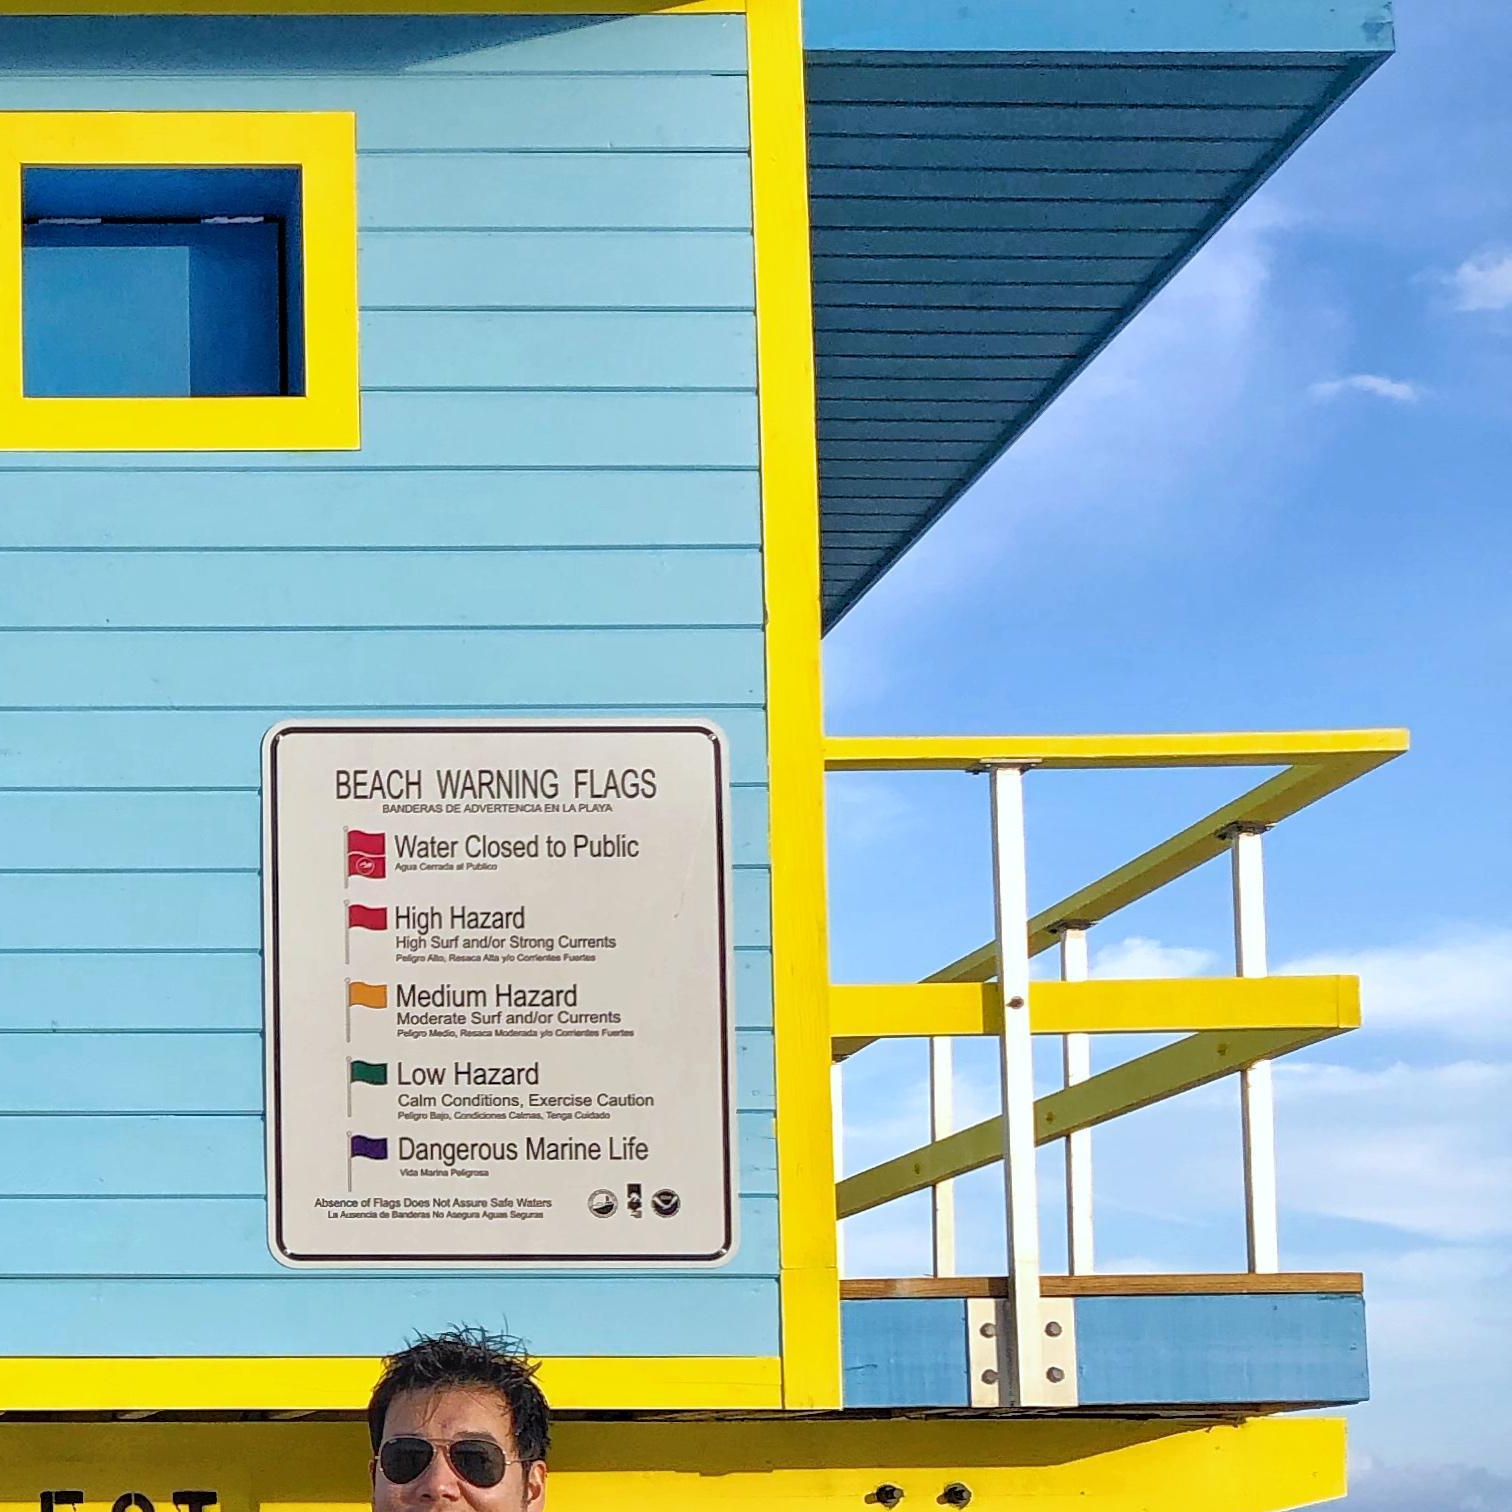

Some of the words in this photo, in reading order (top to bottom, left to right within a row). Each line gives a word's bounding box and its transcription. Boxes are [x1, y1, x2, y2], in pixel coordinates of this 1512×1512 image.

[336, 770, 421, 800] BEACH
[437, 769, 558, 800] WARNING
[574, 769, 657, 799] FLAGS
[382, 803, 443, 814] BANDERAS
[445, 803, 461, 814] DE
[463, 803, 543, 814] ADVERTENCIA
[544, 803, 560, 813] EN
[562, 803, 577, 813] LA
[578, 803, 613, 813] PLAYA
[394, 835, 459, 859] Water
[465, 835, 539, 859] Closed
[545, 836, 567, 858] to
[573, 834, 640, 858] Public
[395, 906, 443, 936] High
[450, 906, 526, 930] Hazard
[395, 935, 427, 953] High
[430, 935, 460, 949] Surf
[462, 935, 507, 949] and/or
[509, 934, 555, 952] Strong
[557, 934, 617, 949] Currents
[396, 984, 487, 1008] Medium
[495, 984, 578, 1008] Hazard
[396, 1011, 467, 1026] Moderate
[470, 1010, 503, 1025] Surf
[505, 1010, 554, 1025] and/or
[556, 1010, 622, 1024] Currents
[398, 1062, 445, 1086] Low
[455, 1062, 539, 1086] Hazard
[398, 1093, 436, 1108] Calm
[441, 1093, 523, 1109] Conditions,
[529, 1093, 592, 1107] Exercise
[597, 1092, 654, 1107] Caution
[399, 1137, 518, 1167] Dangerous
[526, 1137, 601, 1161] Marine
[609, 1136, 649, 1161] Life
[314, 1197, 359, 1208] Absence
[360, 1197, 372, 1208] of
[373, 1197, 402, 1210] Flags
[403, 1197, 431, 1208] Does
[432, 1197, 451, 1208] Not
[452, 1197, 488, 1208] Assure
[490, 1197, 514, 1208] Safe
[516, 1197, 553, 1208] Waters
